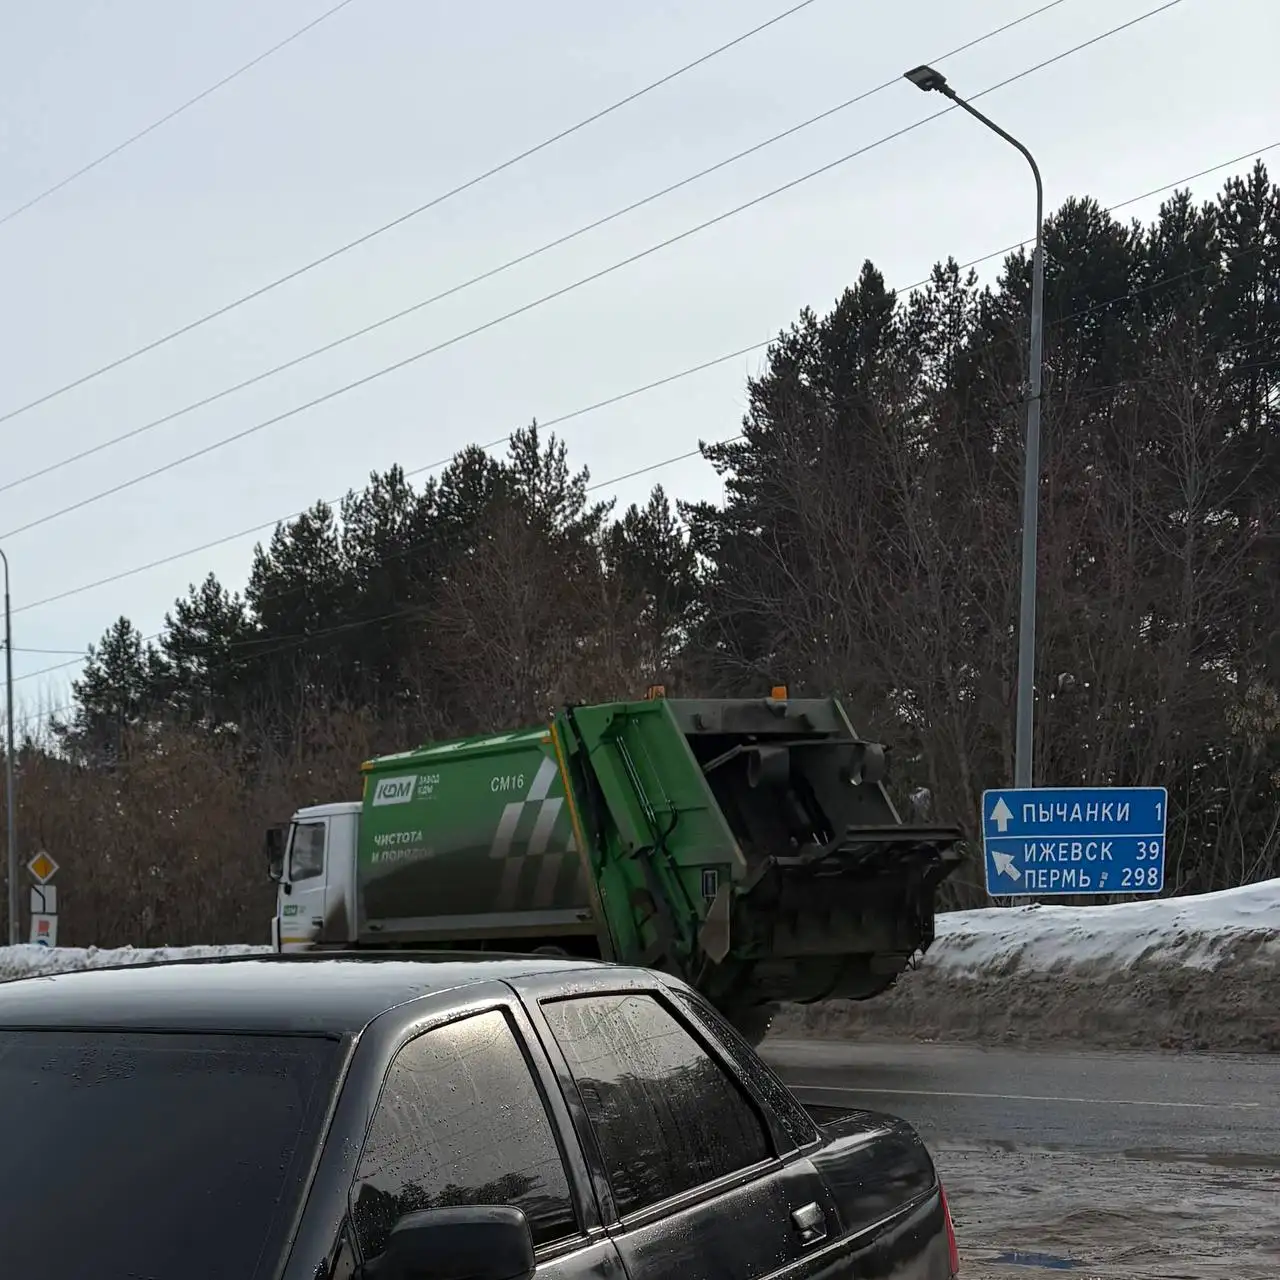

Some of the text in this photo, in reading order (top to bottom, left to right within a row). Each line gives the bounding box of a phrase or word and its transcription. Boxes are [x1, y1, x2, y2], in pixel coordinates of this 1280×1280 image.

[1023, 803, 1162, 823] ПЫЧАНКИ 1
[374, 831, 423, 846] ЧИСТОТА
[1024, 841, 1160, 862] ИЖЕВСК 39
[1024, 867, 1159, 888] ПЕРМЬ 298
